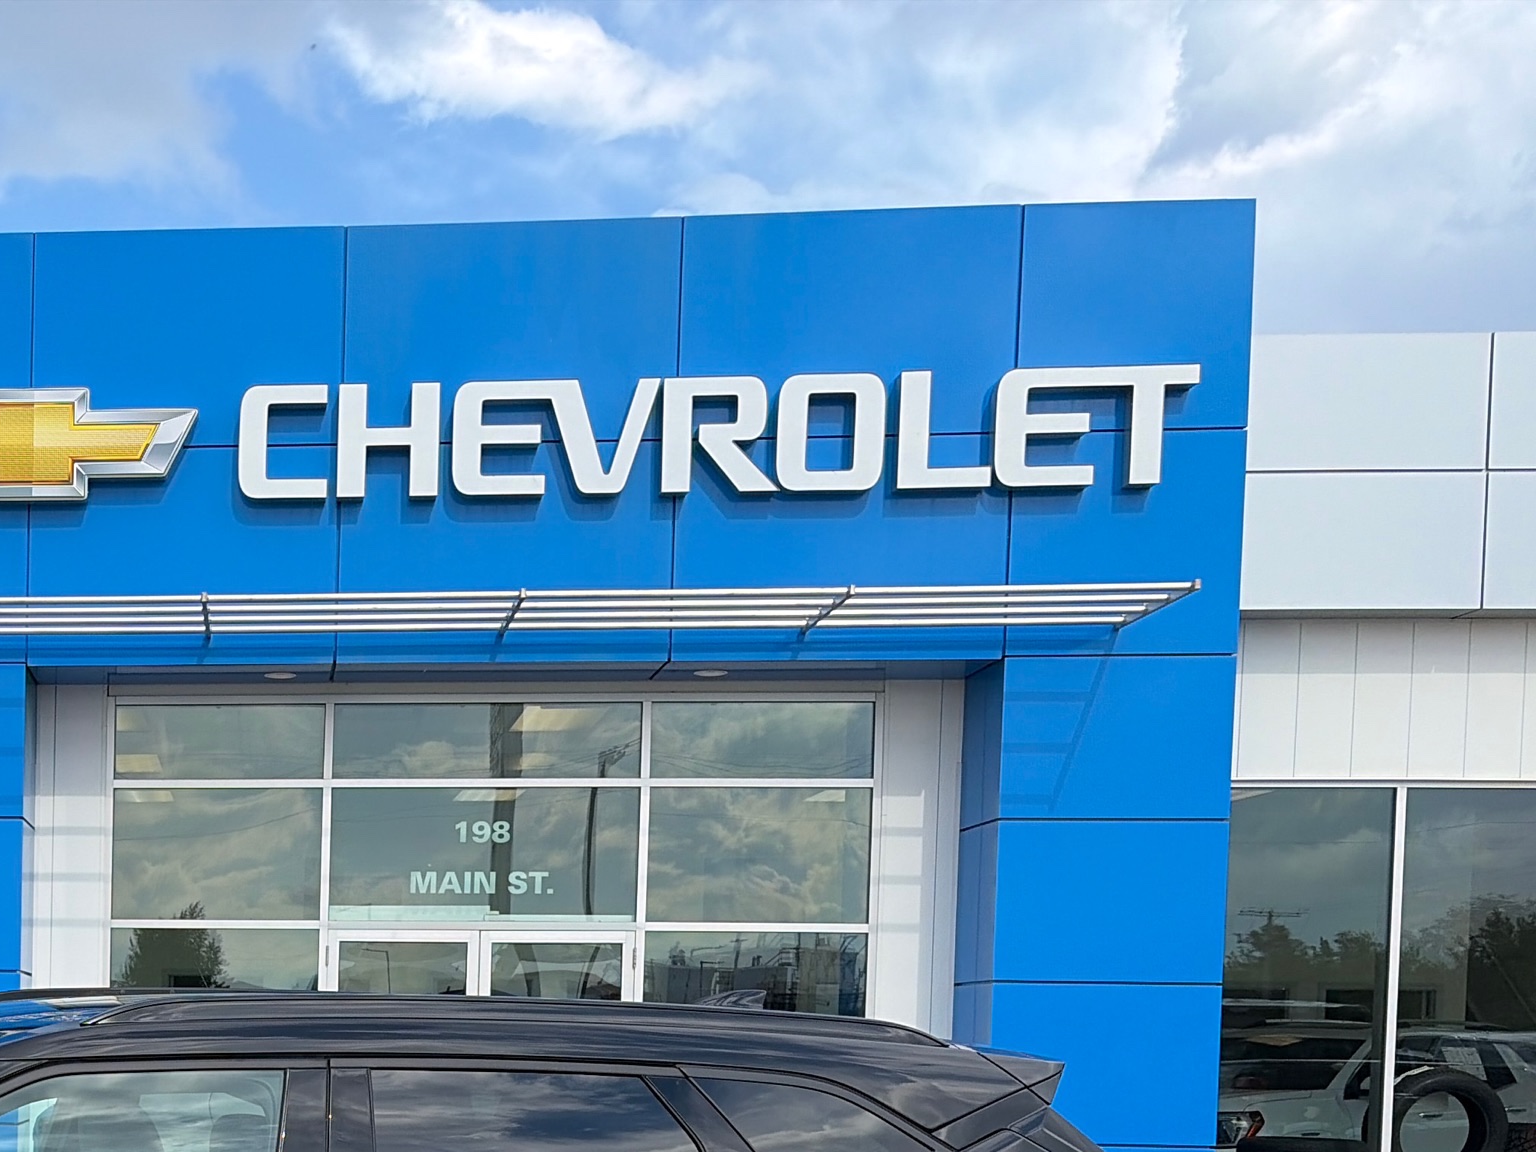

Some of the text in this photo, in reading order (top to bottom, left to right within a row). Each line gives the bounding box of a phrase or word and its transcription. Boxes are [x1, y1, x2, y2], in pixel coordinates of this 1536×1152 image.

[238, 363, 1201, 499] CHEVROLET
[455, 821, 511, 843] 198
[410, 871, 554, 895] MAIN ST.
